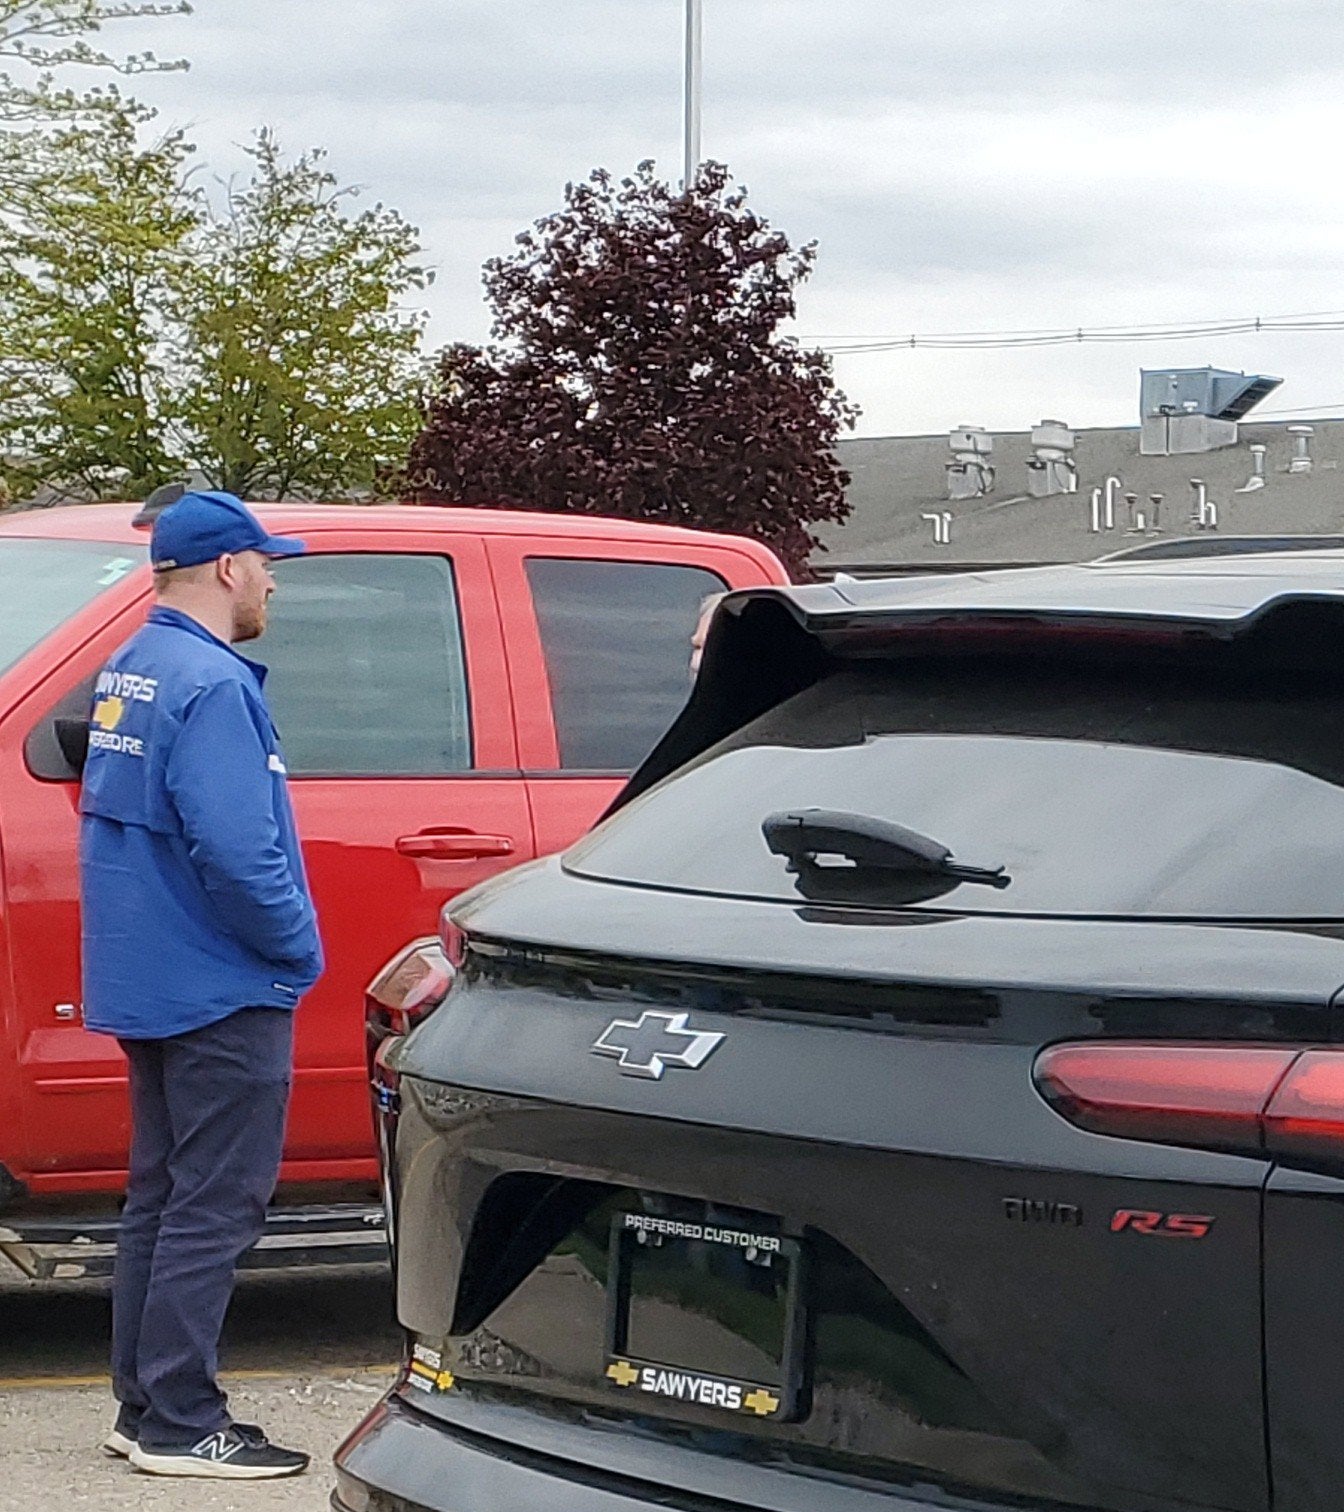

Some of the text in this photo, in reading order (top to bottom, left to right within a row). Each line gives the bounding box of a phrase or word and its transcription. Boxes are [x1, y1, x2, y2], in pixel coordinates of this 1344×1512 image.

[624, 1213, 781, 1251] PREFERRED CUSTOMER
[1110, 1208, 1217, 1239] RS
[640, 1366, 742, 1410] SAWYERS
